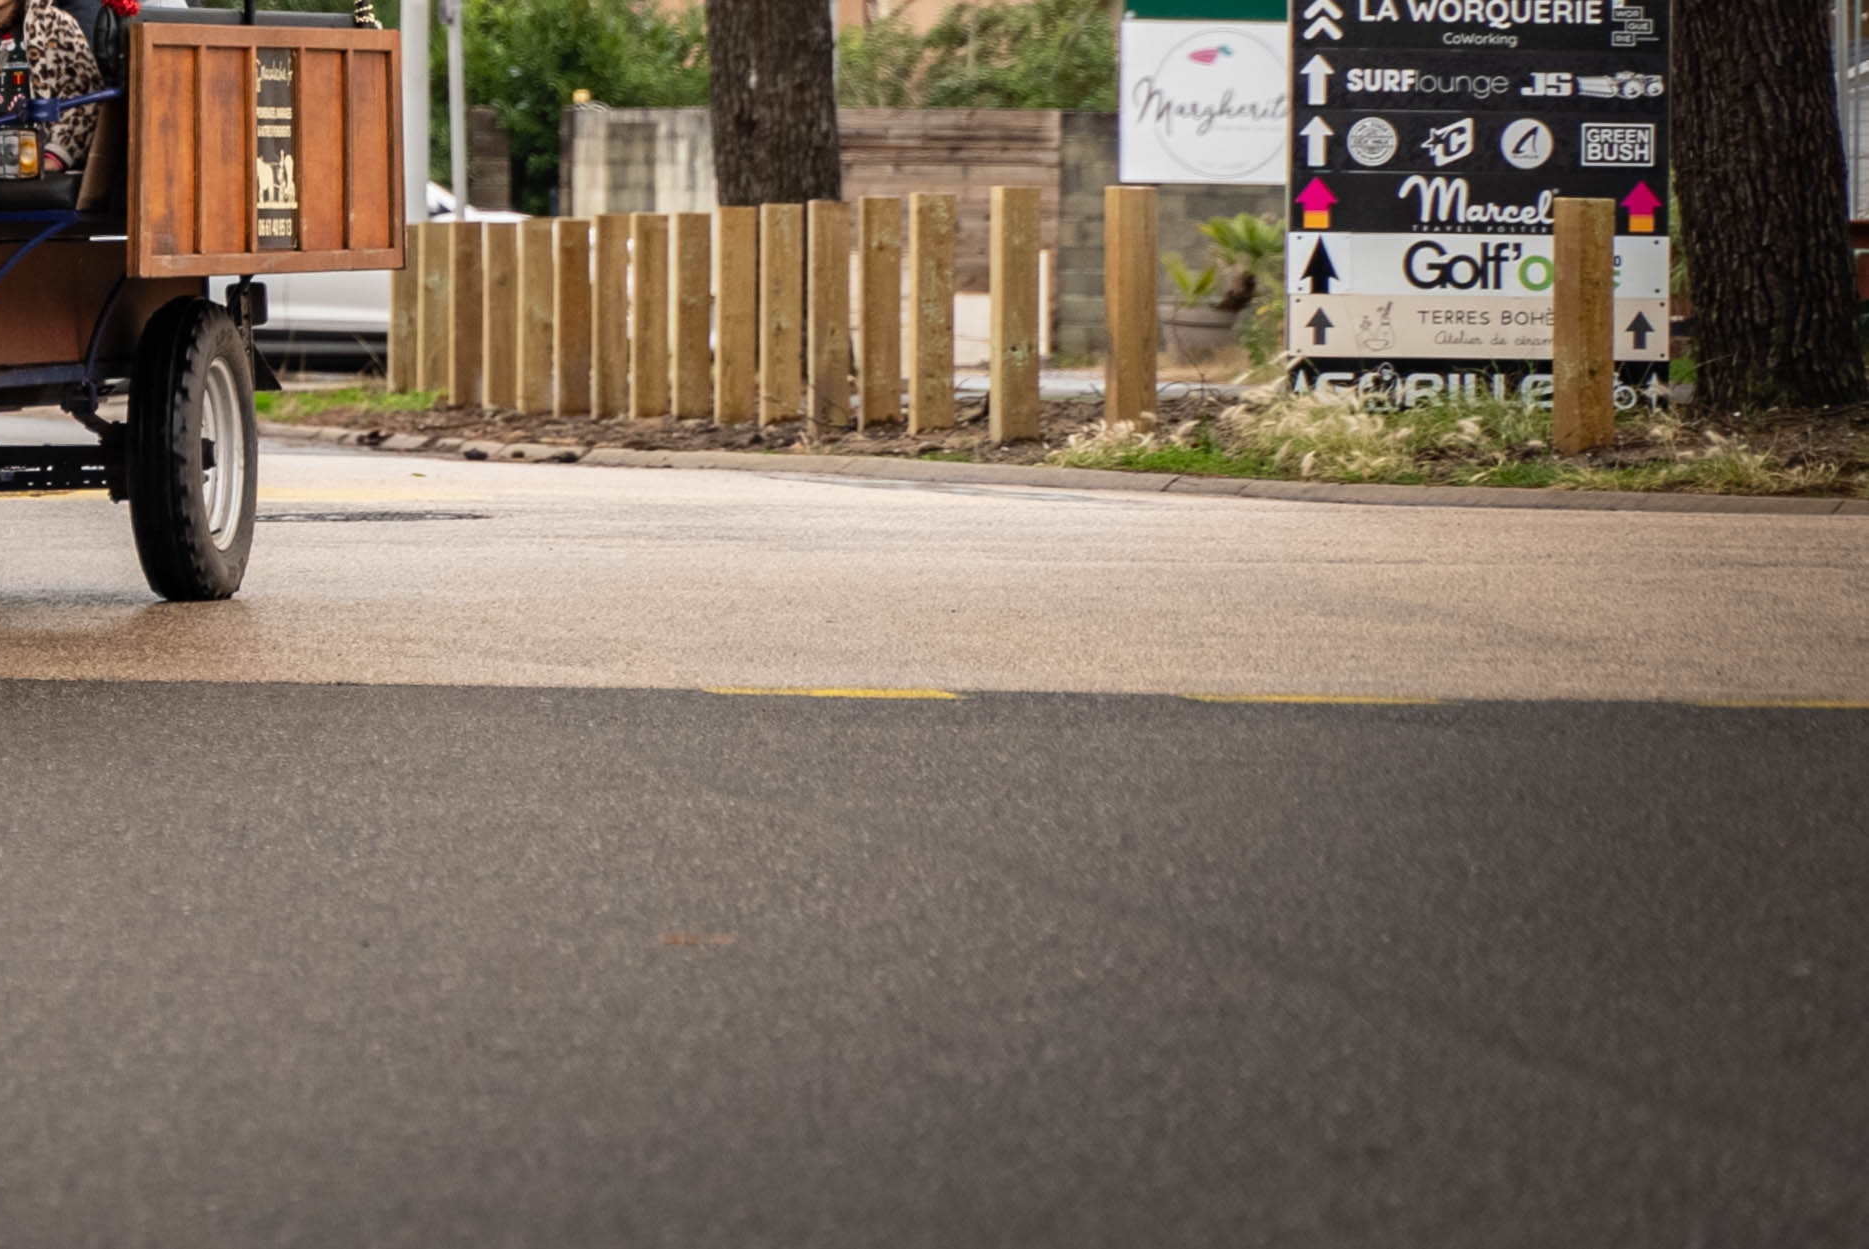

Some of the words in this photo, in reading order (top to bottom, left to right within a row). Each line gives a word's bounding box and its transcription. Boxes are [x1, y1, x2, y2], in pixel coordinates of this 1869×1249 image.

[1520, 72, 1574, 97] JS
[1132, 74, 1289, 137] Margherit
[1586, 128, 1650, 143] GREEN
[1586, 143, 1650, 161] BUSH
[1398, 174, 1555, 225] Marcel
[1412, 224, 1473, 233] TRAVEL
[1417, 310, 1491, 326] TERRES
[1501, 307, 1555, 327] BOHÈ
